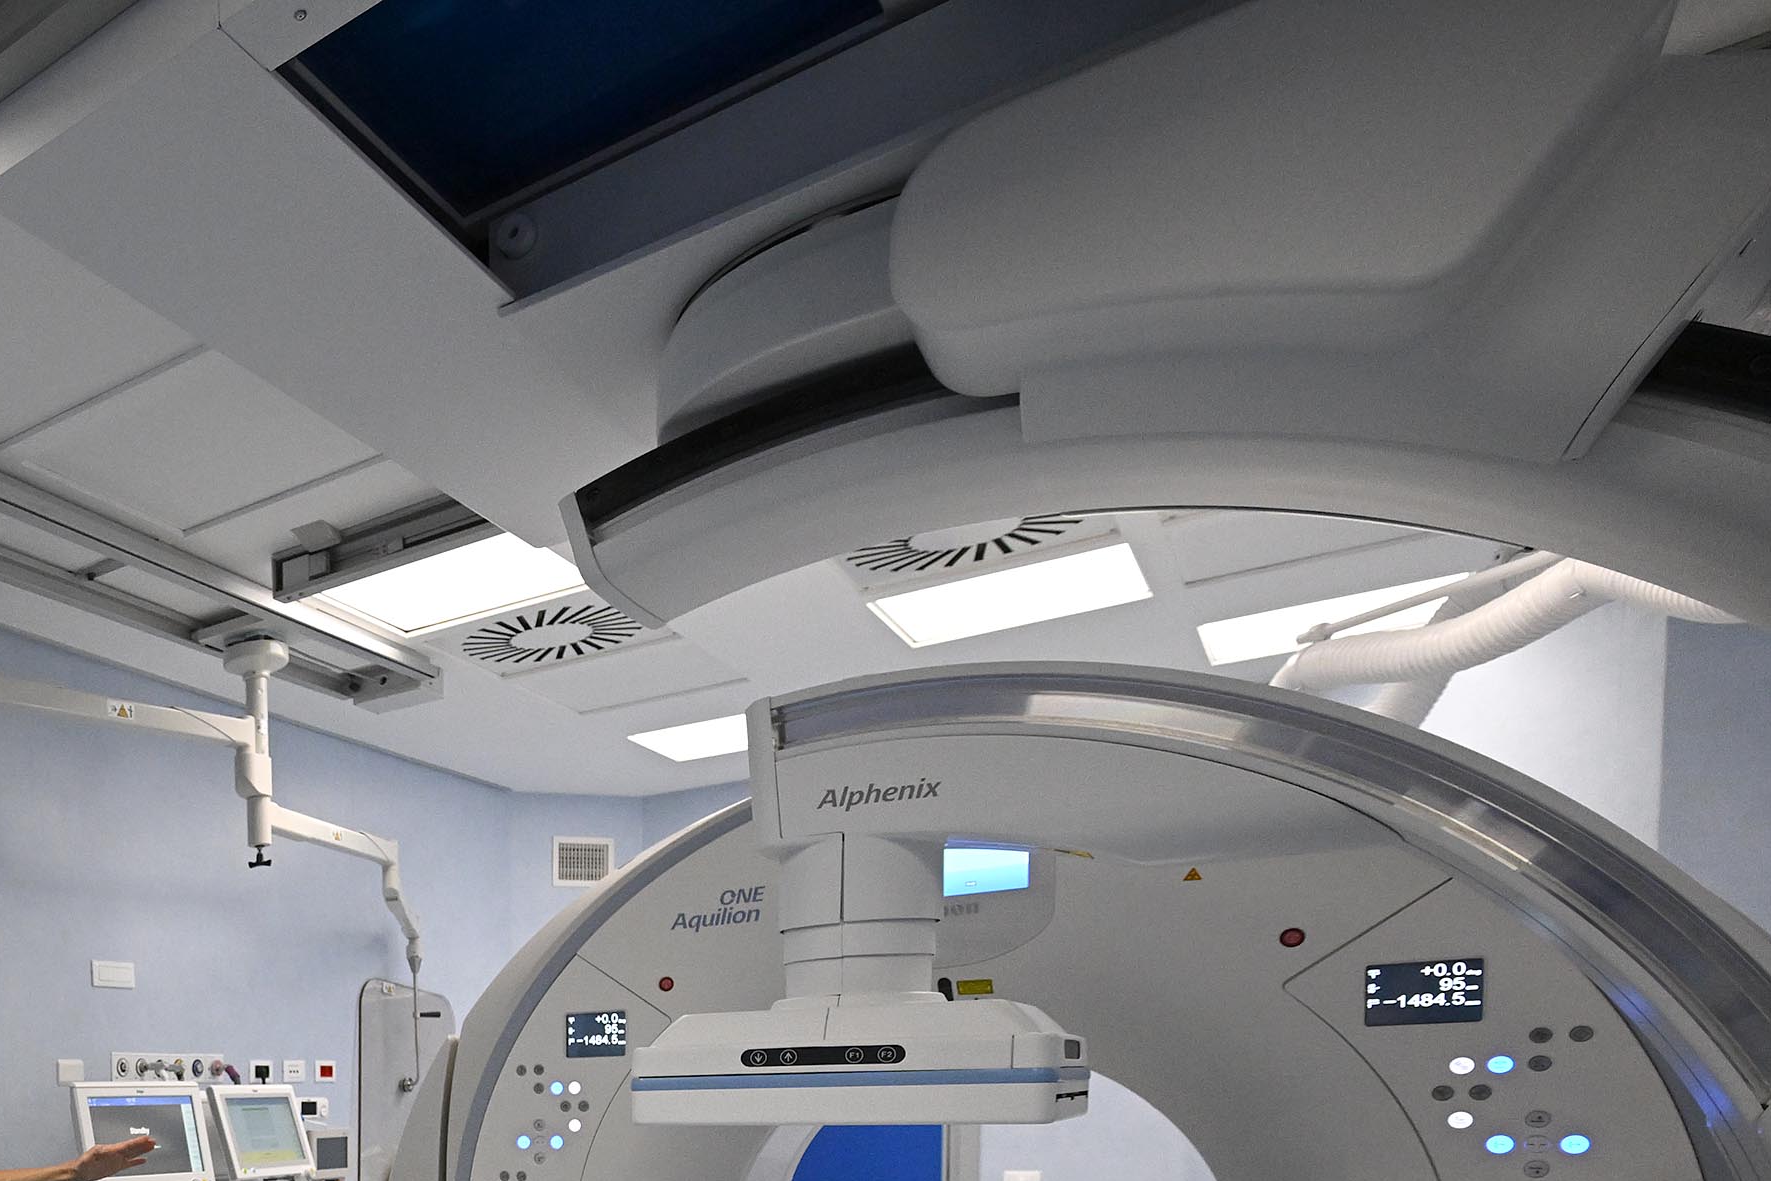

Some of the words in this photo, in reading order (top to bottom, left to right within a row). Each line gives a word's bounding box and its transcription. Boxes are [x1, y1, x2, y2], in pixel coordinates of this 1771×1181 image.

[816, 777, 942, 812] Alphenix
[719, 885, 766, 906] ONE
[670, 907, 761, 932] Aquilion
[1438, 976, 1467, 992] 95
[849, 1051, 860, 1059] F1
[880, 1050, 893, 1059] F2
